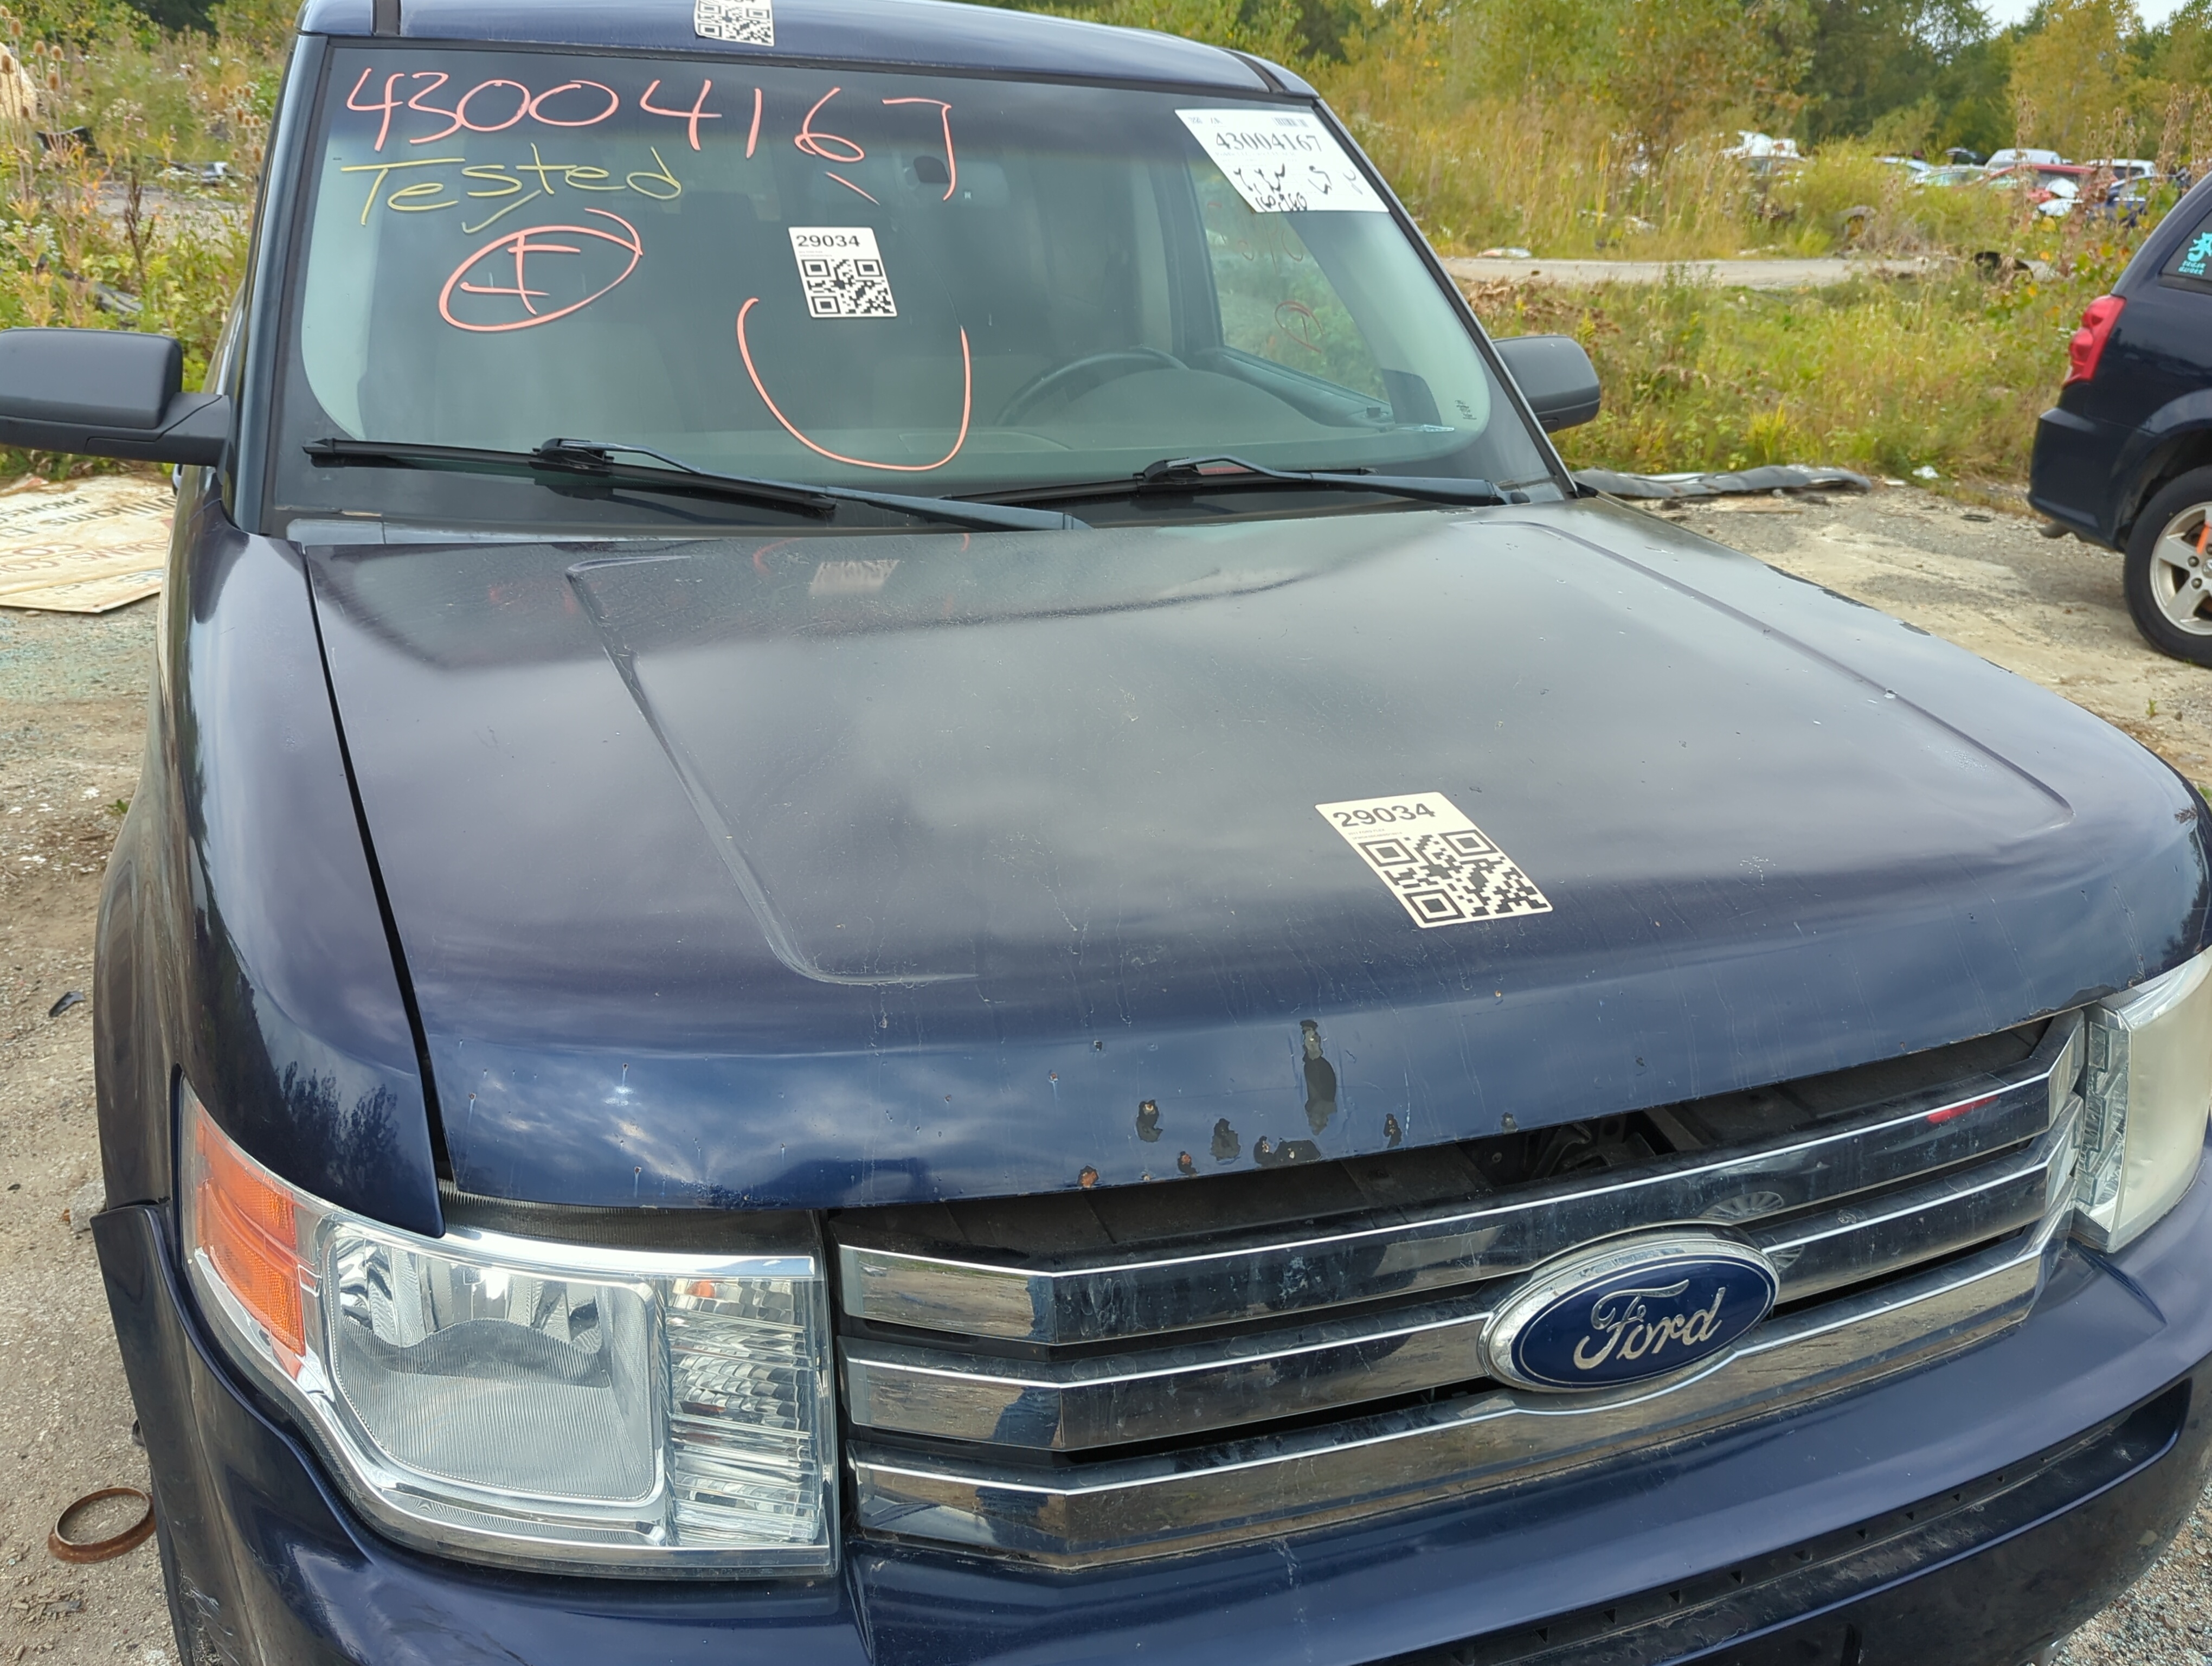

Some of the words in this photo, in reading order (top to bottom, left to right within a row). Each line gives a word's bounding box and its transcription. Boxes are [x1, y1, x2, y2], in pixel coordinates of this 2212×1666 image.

[1216, 132, 1322, 152] 43004167
[340, 142, 682, 226] Tested
[795, 235, 860, 247] 29034
[1333, 803, 1436, 828] 29034
[1572, 1279, 1726, 1370] Ford
